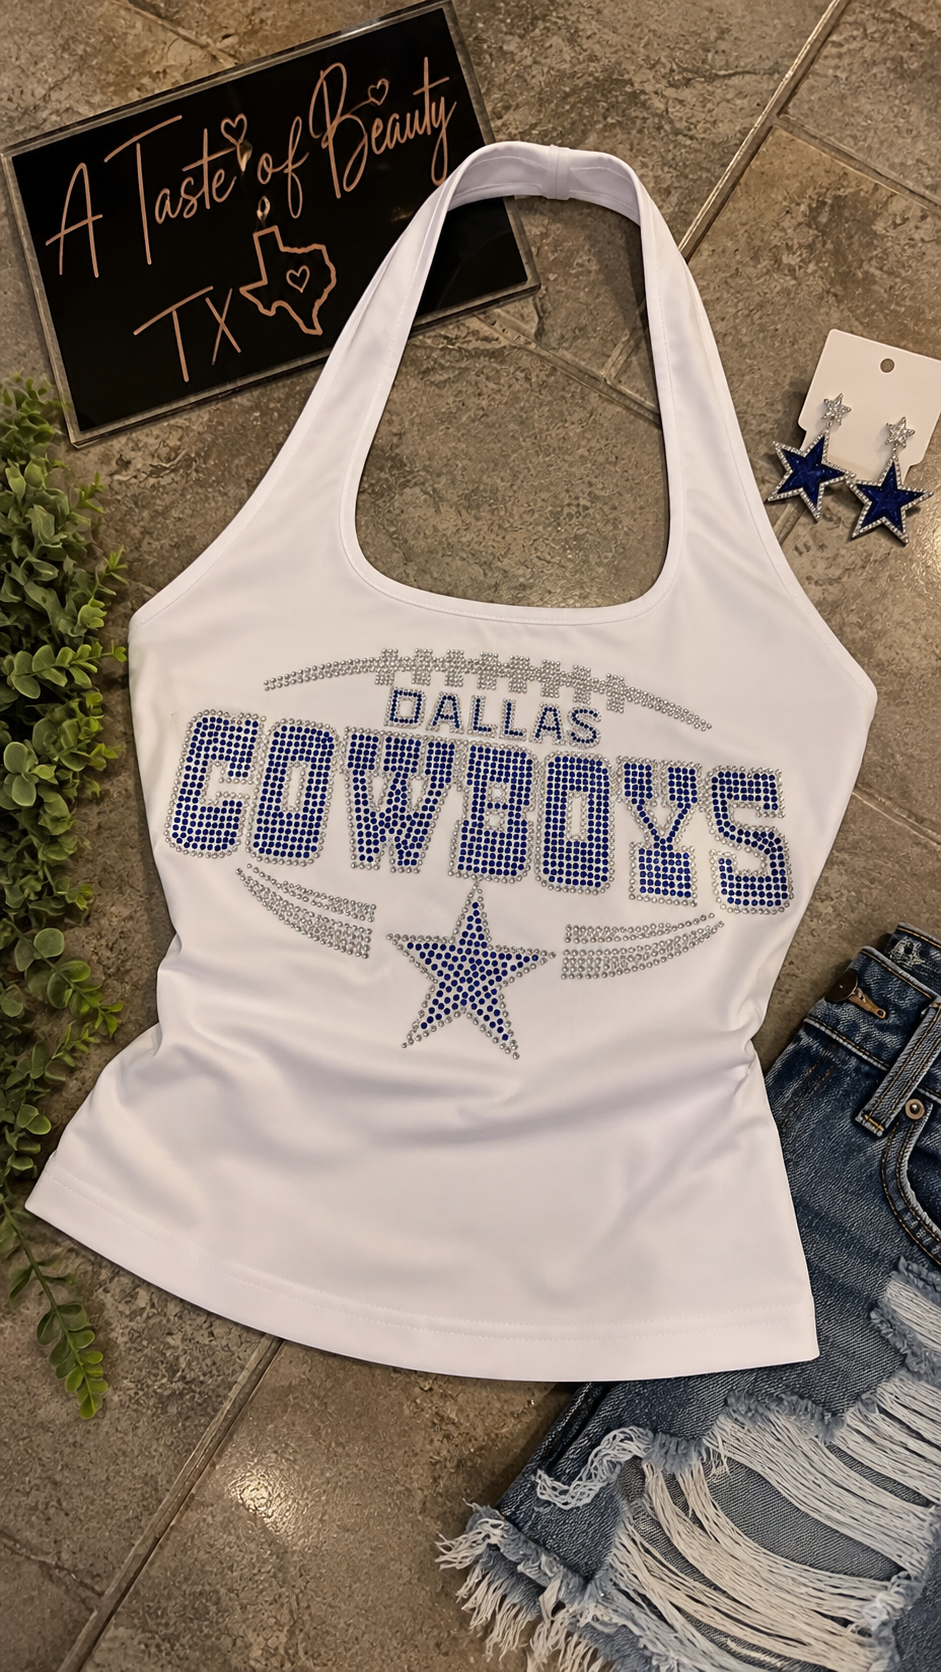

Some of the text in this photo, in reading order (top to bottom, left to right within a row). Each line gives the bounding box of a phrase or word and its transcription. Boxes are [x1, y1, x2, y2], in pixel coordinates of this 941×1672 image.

[46, 57, 457, 278] A Taste of Beauty
[133, 286, 241, 382] TX
[384, 687, 602, 748] DALLAS
[164, 709, 794, 915] COWBOYS
